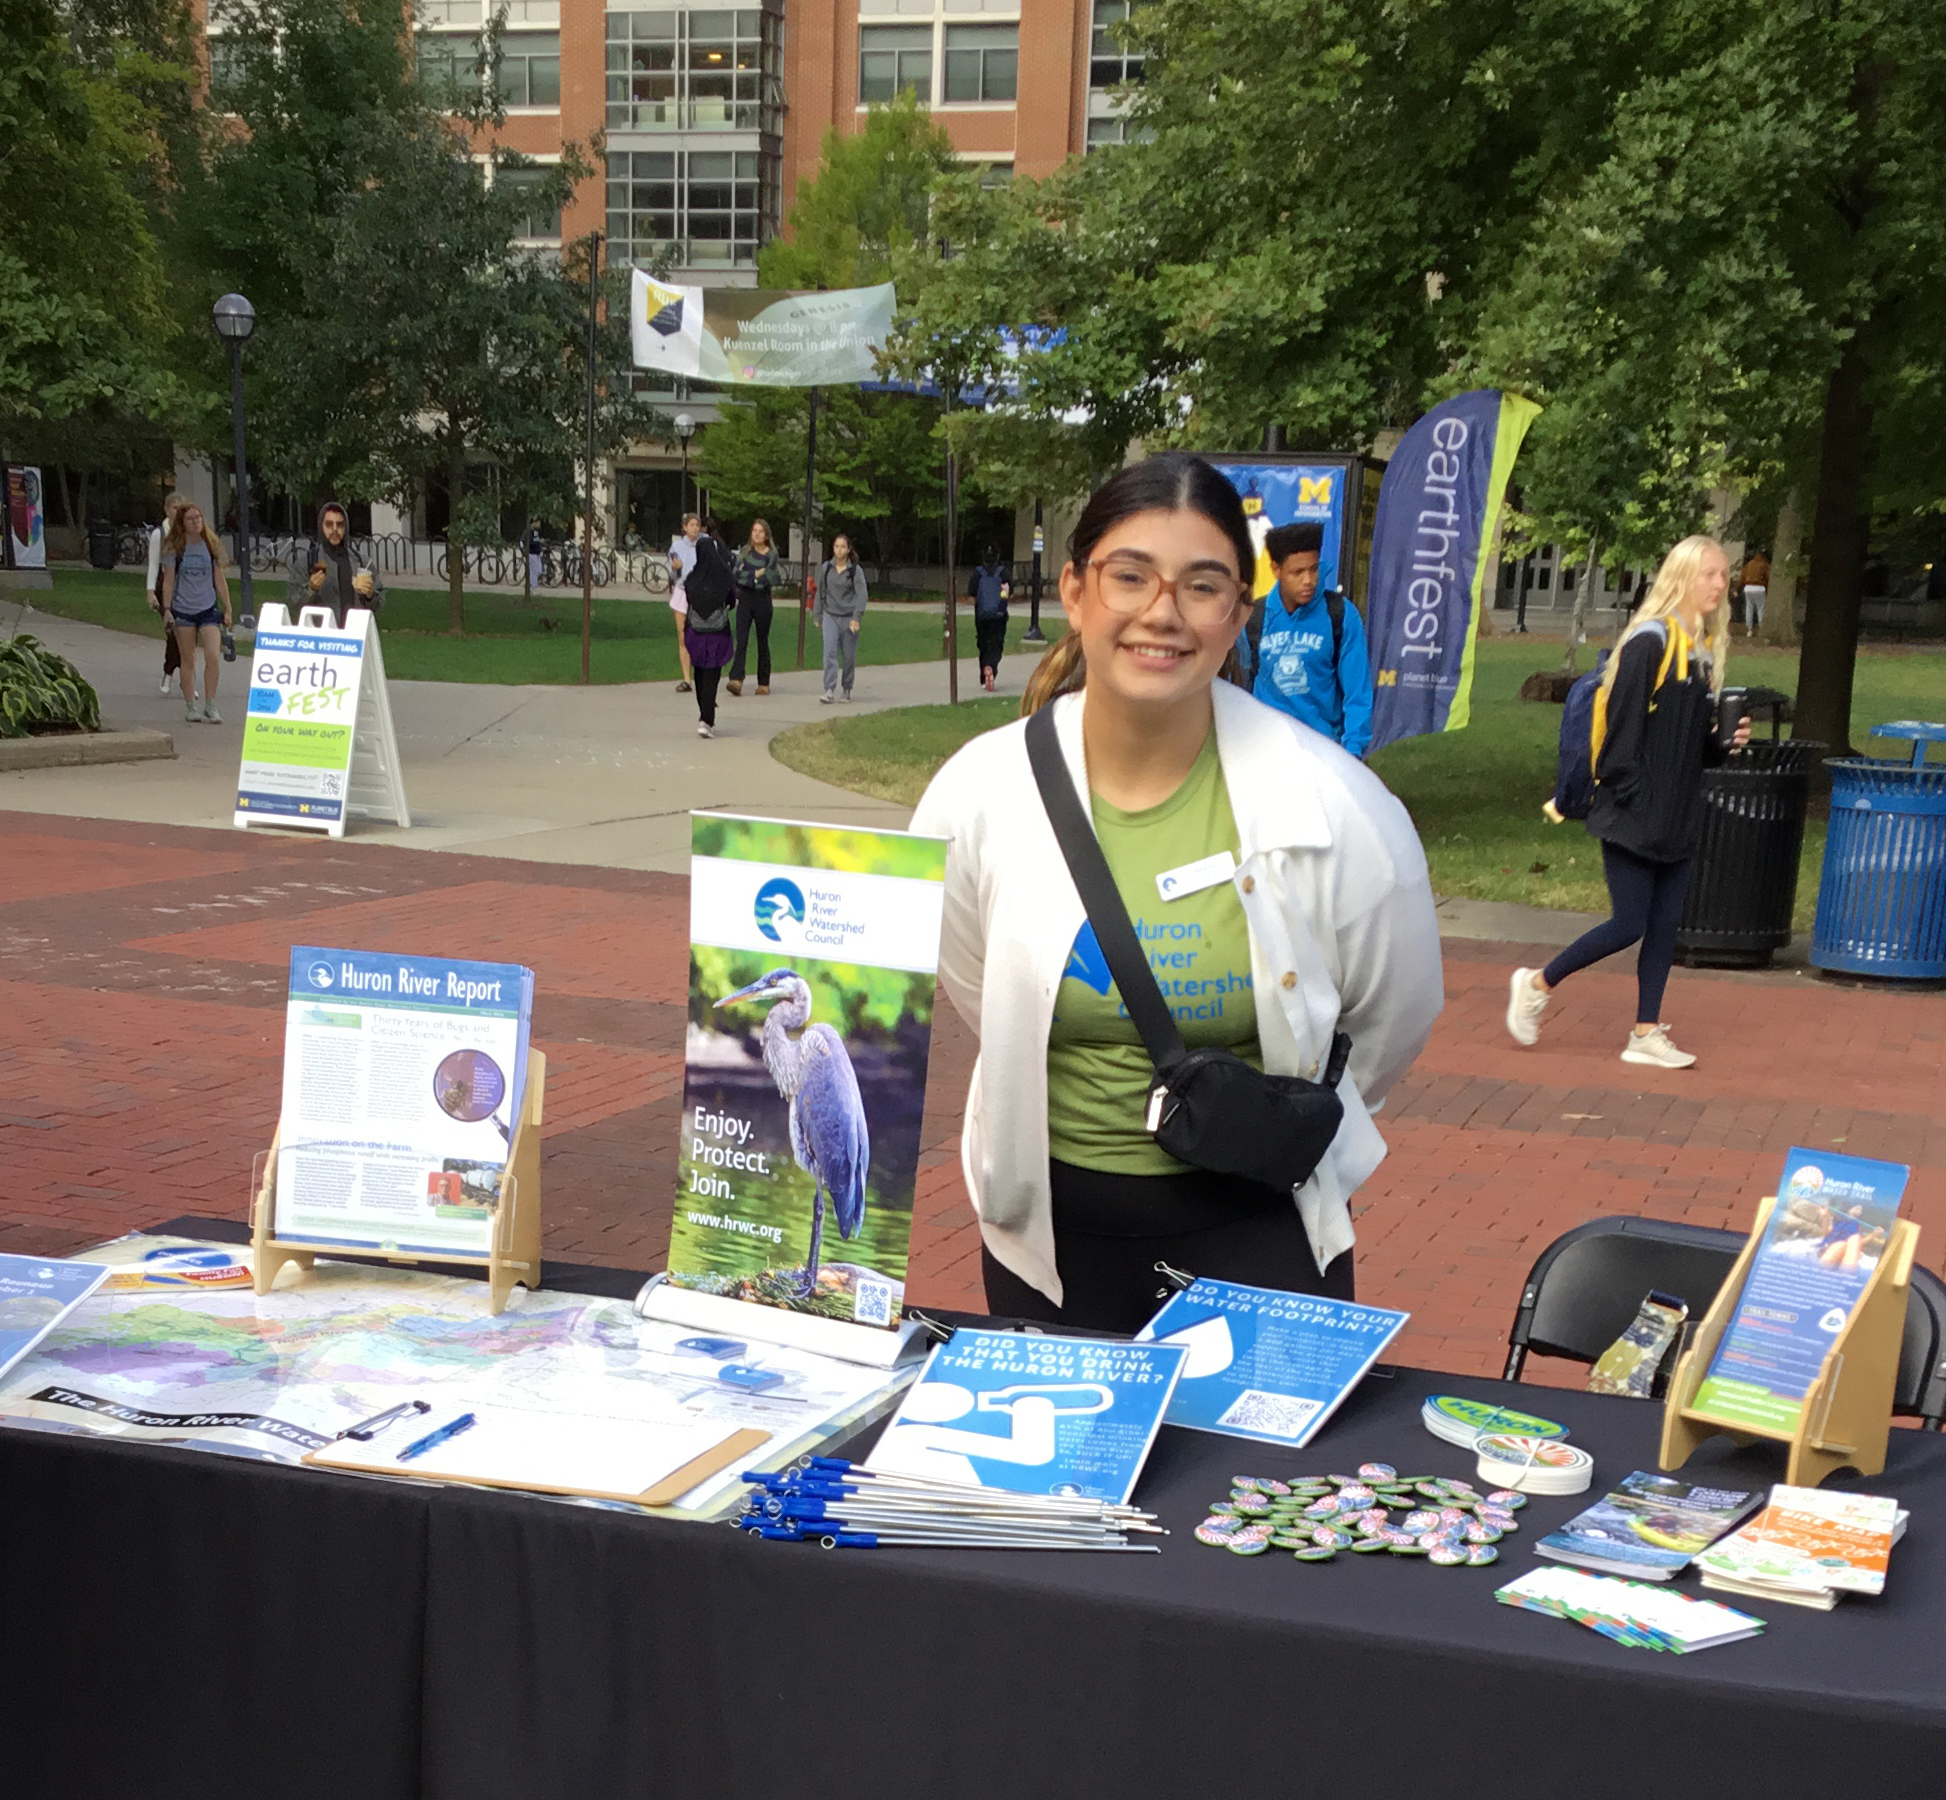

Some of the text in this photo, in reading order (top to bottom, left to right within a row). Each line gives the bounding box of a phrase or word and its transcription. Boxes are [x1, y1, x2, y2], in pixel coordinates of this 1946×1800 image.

[723, 332, 875, 351] Kuenzel Room in the Union
[737, 319, 811, 339] Wednesdays
[839, 320, 856, 335] pm
[1298, 477, 1333, 504] M
[1401, 417, 1468, 659] earthfest
[260, 636, 359, 654] THANKS FOR VISITING
[1294, 630, 1324, 651] LAKE
[257, 656, 338, 689] earth
[1378, 669, 1397, 687] M
[286, 685, 352, 716] FEST
[255, 722, 346, 741] ON YOUR WAY OUT?
[809, 888, 842, 903] Huron
[811, 902, 838, 917] River
[804, 930, 844, 946] Council
[809, 917, 866, 935] Watershed
[1150, 946, 1198, 969] iver
[341, 962, 392, 993] Huron
[398, 968, 440, 997] River
[447, 971, 502, 1008] Report
[371, 1024, 406, 1037] Citizen
[409, 1028, 446, 1041] Science
[372, 1013, 490, 1034] Thirty Years of Bugs and
[694, 1105, 755, 1145] Enjoy.
[351, 1140, 366, 1149] on
[367, 1140, 384, 1150] the
[691, 1137, 770, 1174] Protect.
[689, 1169, 735, 1200] Join.
[1824, 1177, 1876, 1194] Huron River
[687, 1210, 783, 1244] www.hrwc.org
[1185, 1293, 1385, 1335] WATER FOOTPRINT?
[1188, 1283, 1396, 1327] DO YOU KNOW YOUR
[962, 1346, 1155, 1373] THAT YOU DRINK
[974, 1336, 1151, 1360] DID YOU KNOW
[942, 1355, 1164, 1385] THE HURON RIVER?
[47, 1389, 97, 1409] The
[98, 1403, 182, 1427] Huron
[182, 1413, 255, 1427] River
[1446, 1401, 1550, 1434] HURON
[1780, 1510, 1828, 1526] BIKE
[1833, 1524, 1881, 1537] MAP
